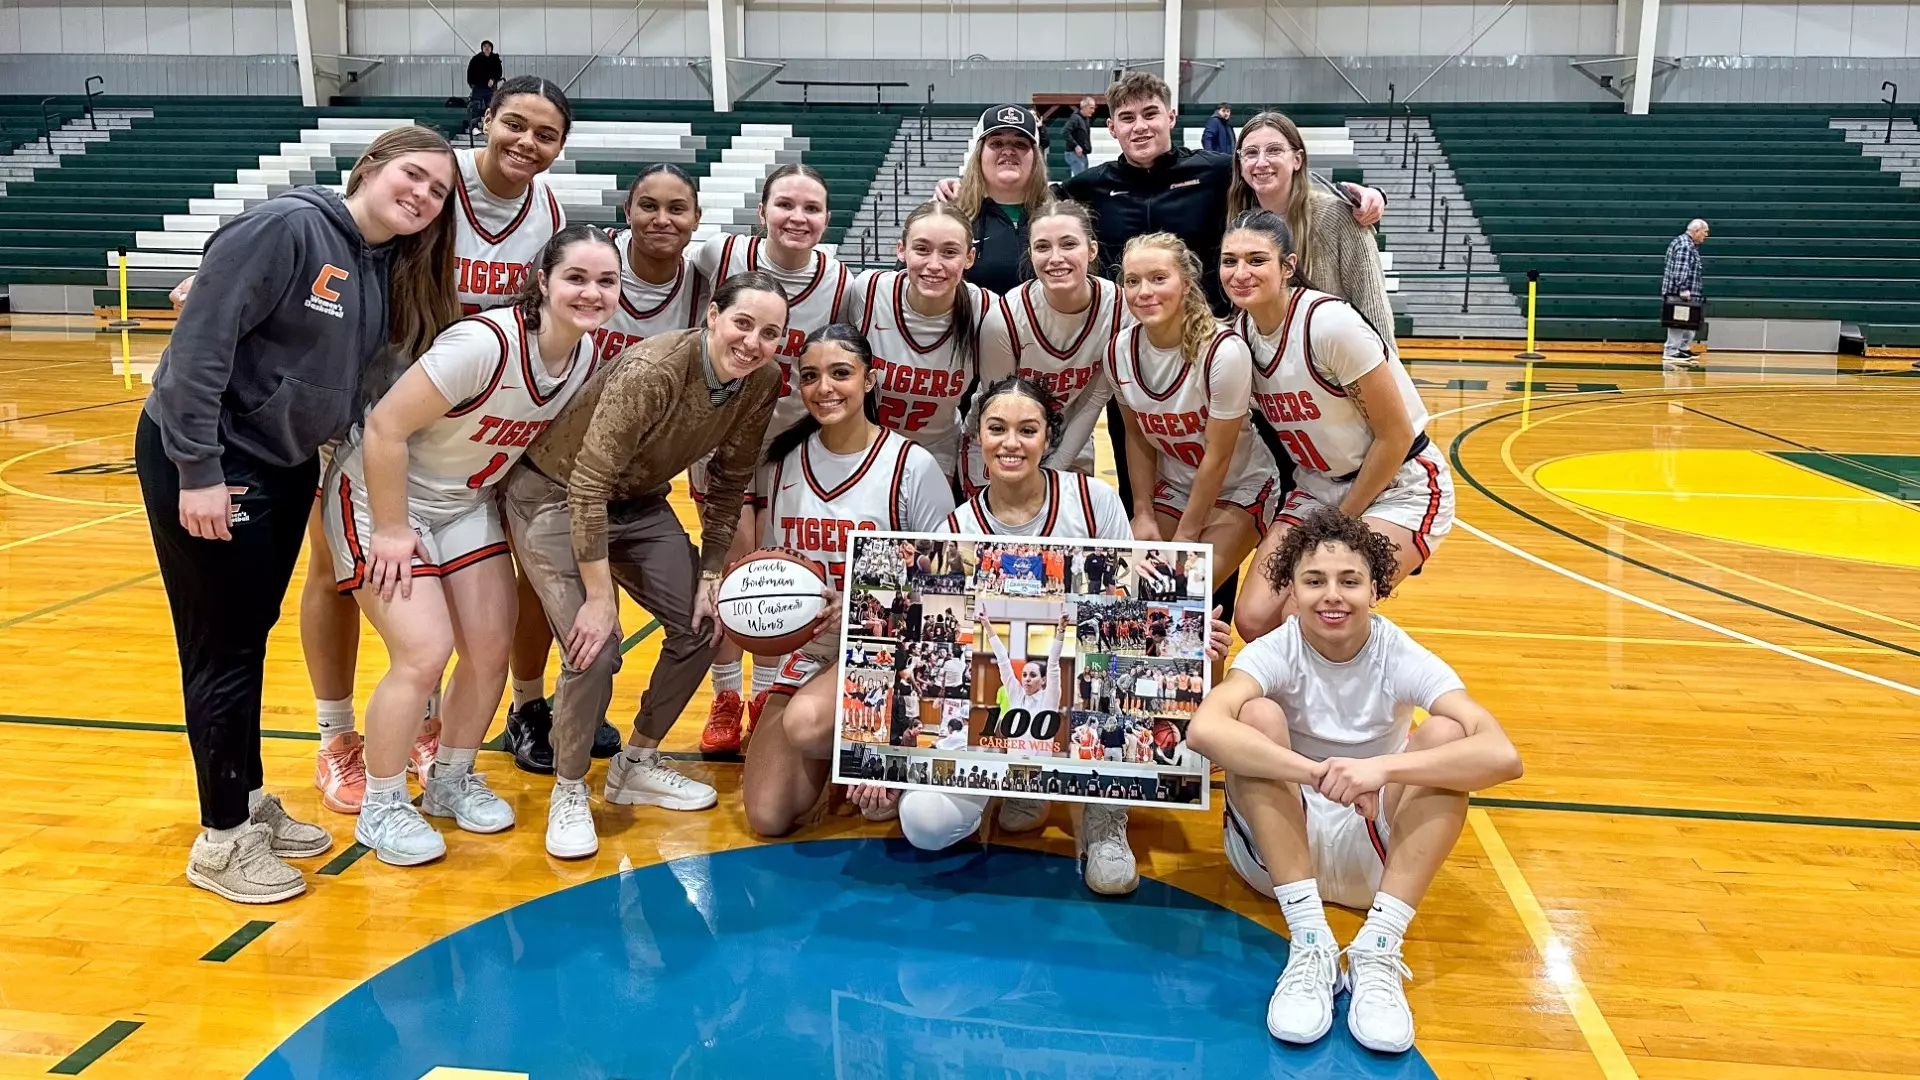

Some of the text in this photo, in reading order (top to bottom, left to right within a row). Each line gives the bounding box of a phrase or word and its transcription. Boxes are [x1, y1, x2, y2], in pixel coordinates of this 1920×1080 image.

[311, 263, 350, 303] C
[310, 295, 343, 312] Women's
[877, 395, 938, 432] 22
[1137, 404, 1209, 437] IGERS
[1275, 429, 1332, 472] 31
[466, 452, 509, 489] 1
[748, 560, 787, 574] Coach
[733, 601, 753, 616] 100
[747, 616, 785, 632] Wins
[979, 706, 1062, 740] 100
[980, 736, 1061, 753] CAREER WINS
